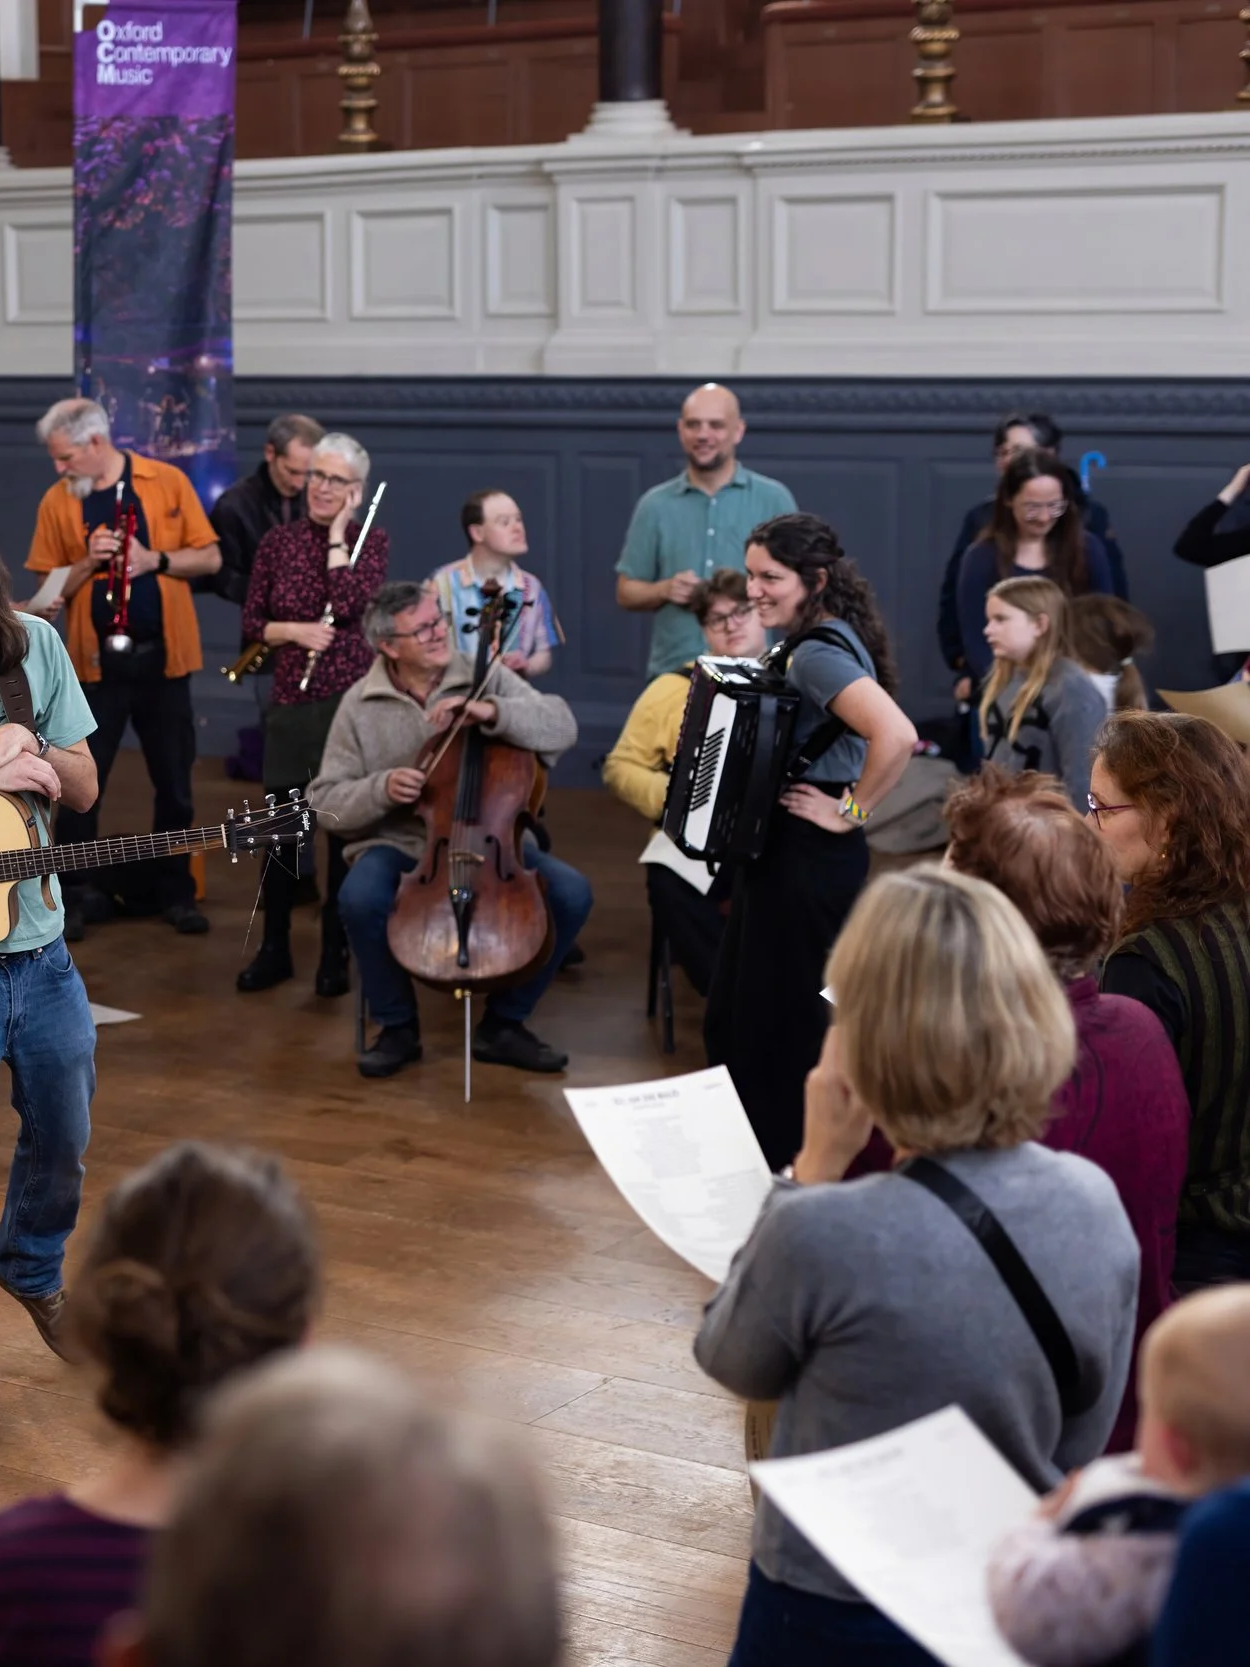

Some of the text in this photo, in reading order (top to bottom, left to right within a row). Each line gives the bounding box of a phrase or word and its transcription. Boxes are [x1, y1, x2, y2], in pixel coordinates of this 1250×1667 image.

[96, 19, 163, 43] Oxford
[96, 42, 233, 68] Contemporary
[96, 63, 154, 85] Music
[302, 810, 311, 831] Taylor
